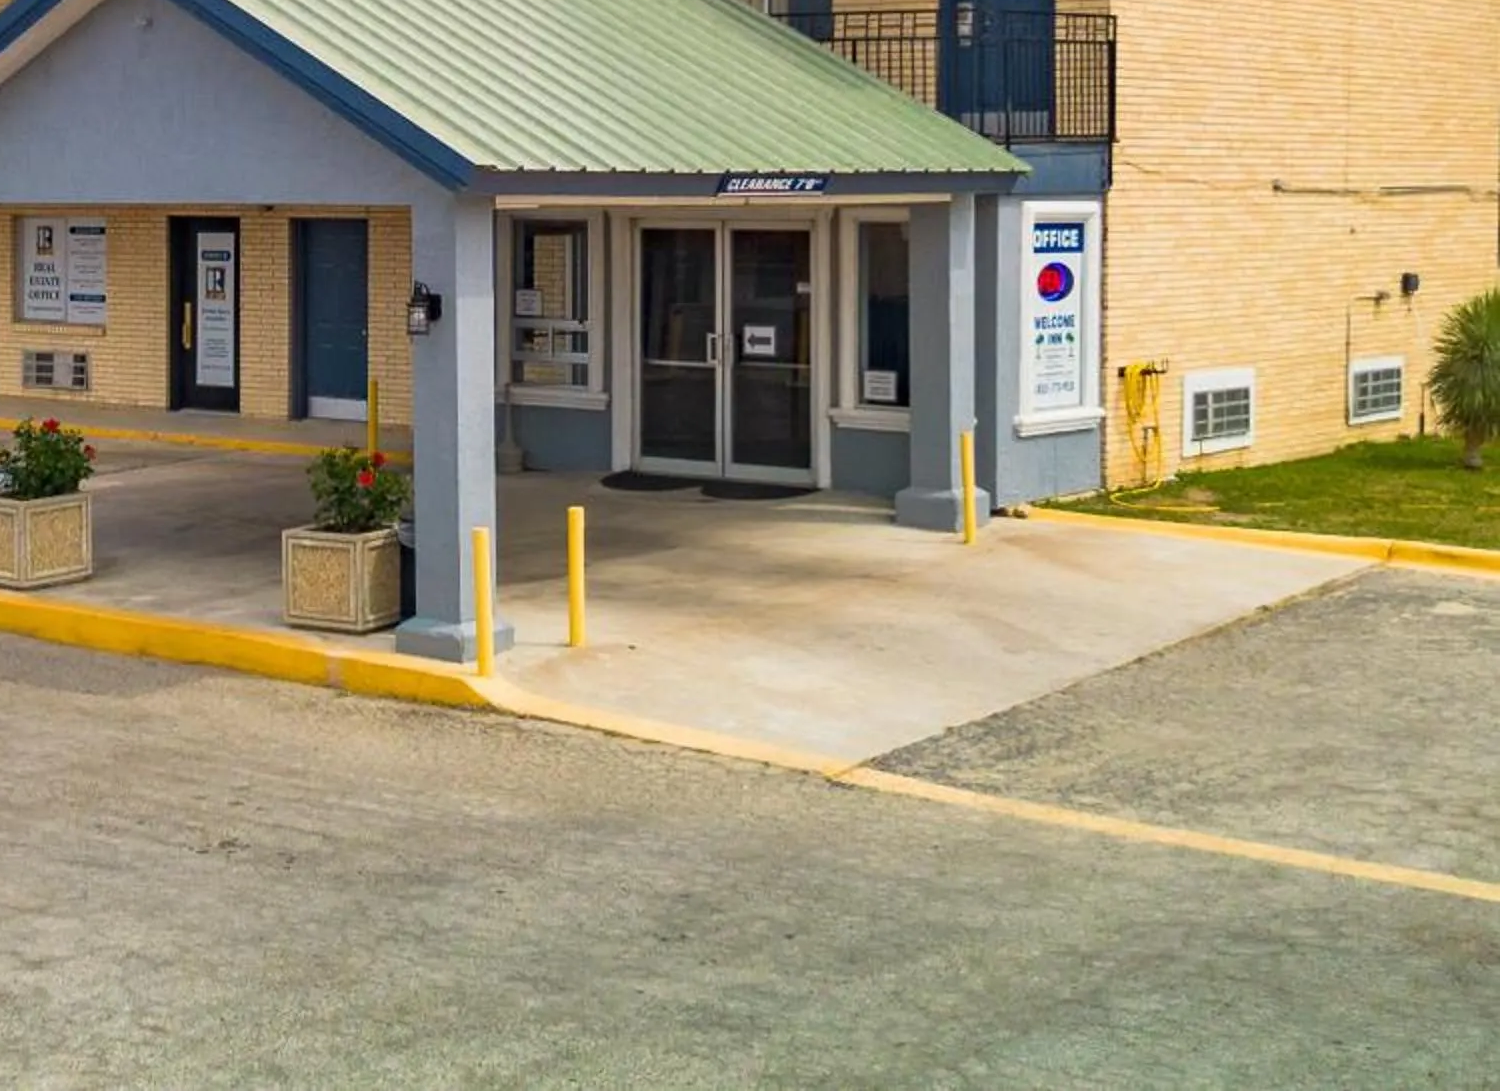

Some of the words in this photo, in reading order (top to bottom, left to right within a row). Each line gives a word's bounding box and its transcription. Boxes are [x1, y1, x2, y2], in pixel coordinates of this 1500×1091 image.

[727, 178, 792, 190] CLEARANCE
[1033, 229, 1079, 247] OFFICE
[34, 262, 55, 274] REAL
[29, 276, 59, 286] ESTATE
[28, 289, 59, 300] OFFICE
[1034, 315, 1075, 329] WELCOME
[1047, 333, 1062, 345] INN
